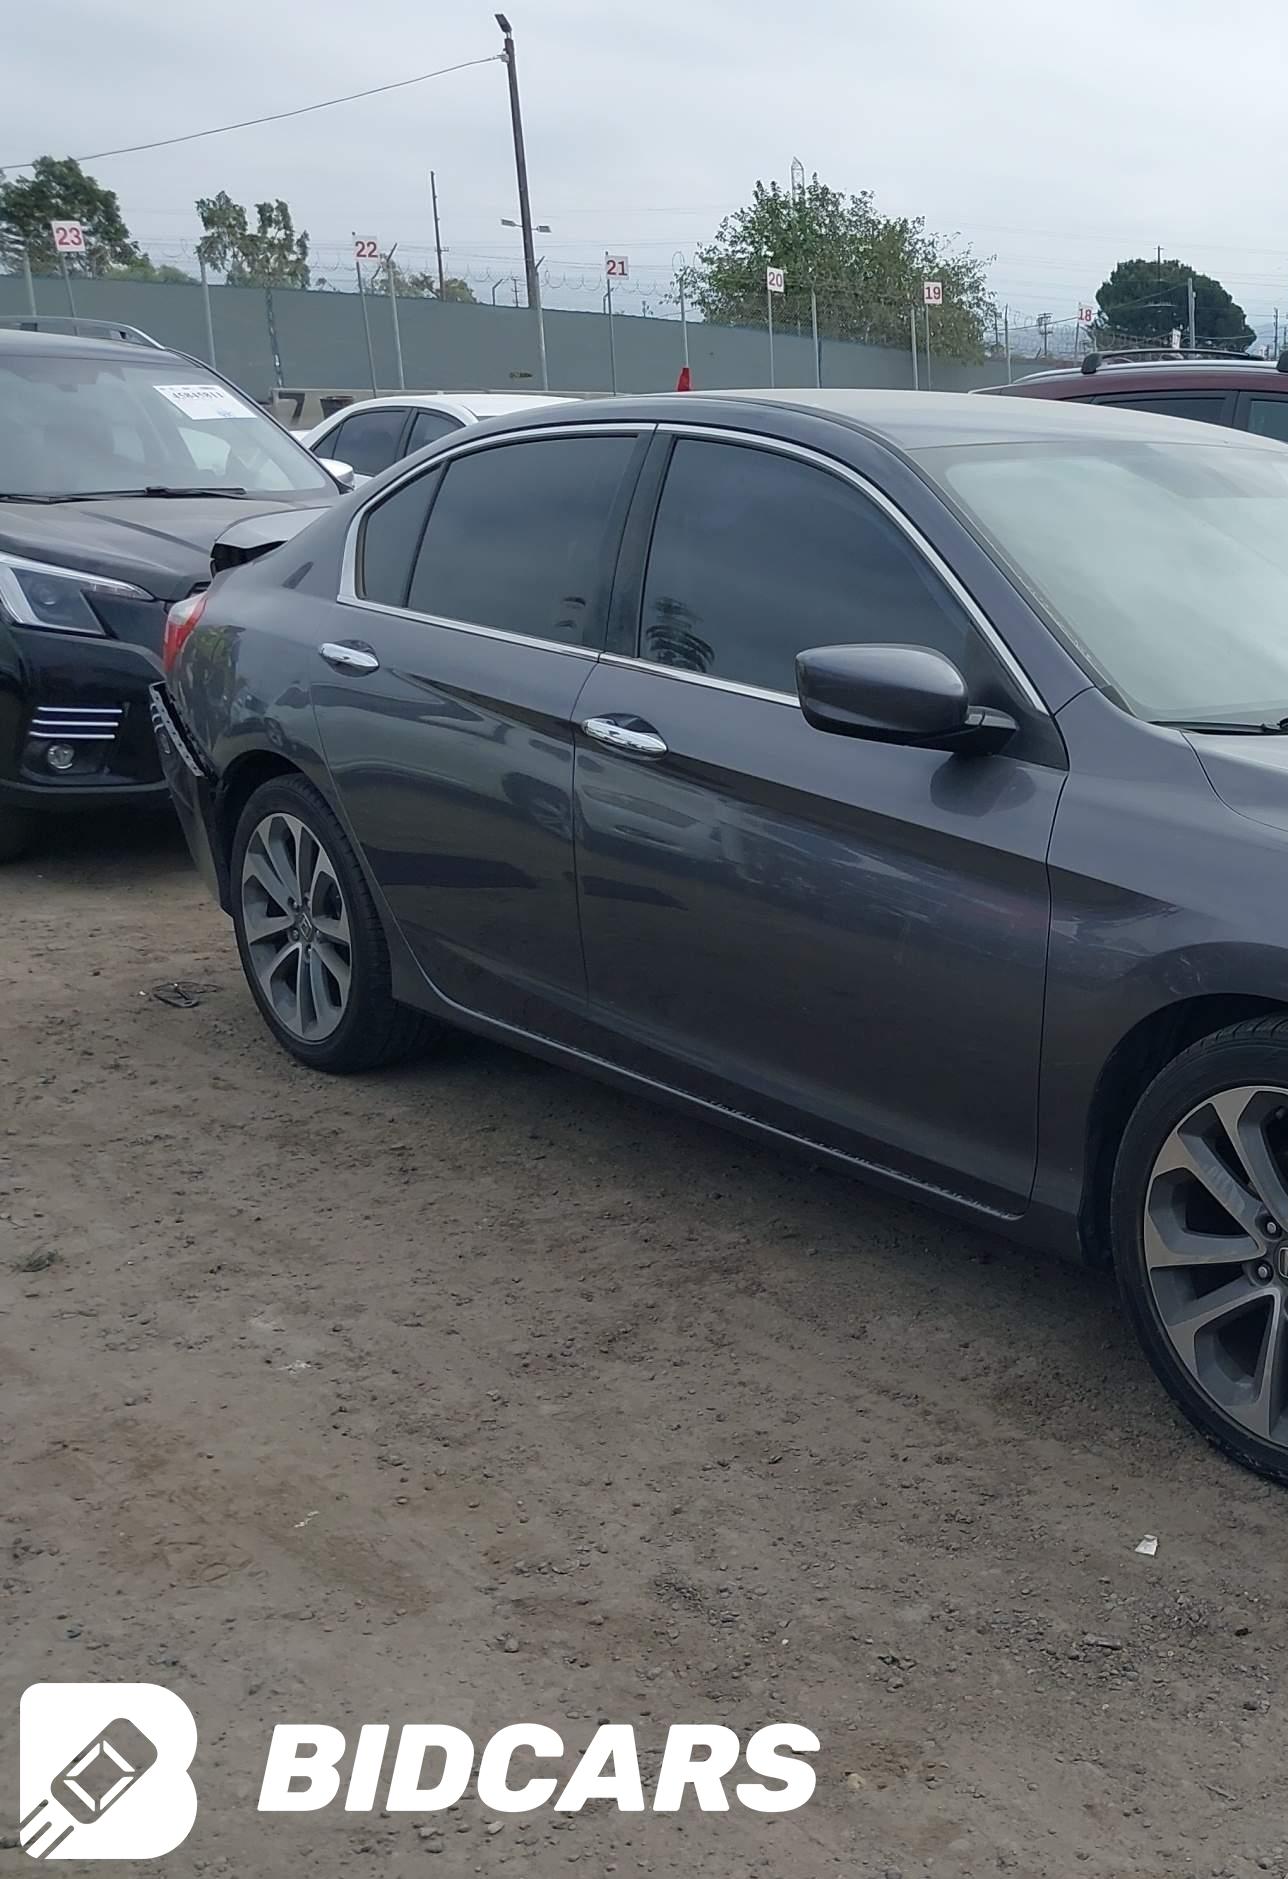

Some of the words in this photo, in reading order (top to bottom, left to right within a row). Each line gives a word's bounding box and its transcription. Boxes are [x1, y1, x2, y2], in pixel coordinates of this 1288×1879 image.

[56, 227, 82, 246] 23
[355, 241, 378, 258] 22
[607, 260, 628, 276] 21
[769, 272, 783, 287] 20
[925, 286, 941, 300] 19
[1079, 308, 1092, 321] 18
